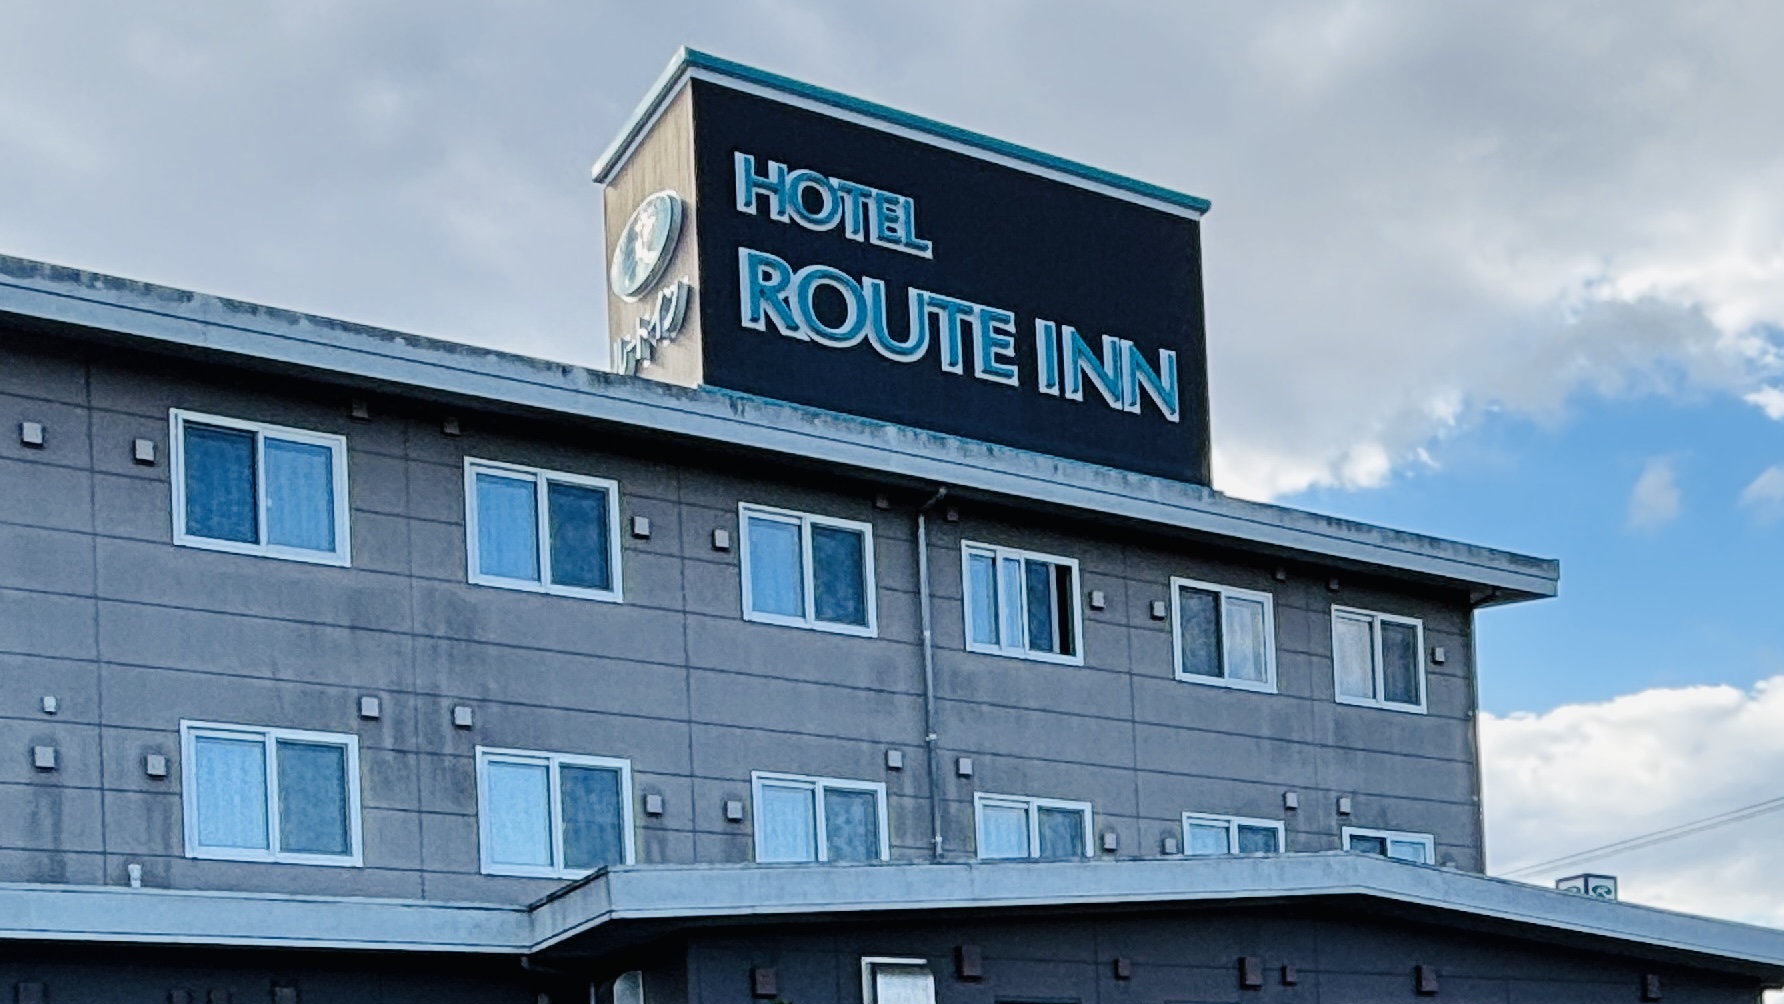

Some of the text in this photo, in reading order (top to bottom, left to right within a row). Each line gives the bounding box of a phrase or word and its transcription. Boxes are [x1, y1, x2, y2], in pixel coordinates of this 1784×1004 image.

[734, 151, 933, 259] HOTEL
[738, 246, 1181, 424] ROUTE INN
